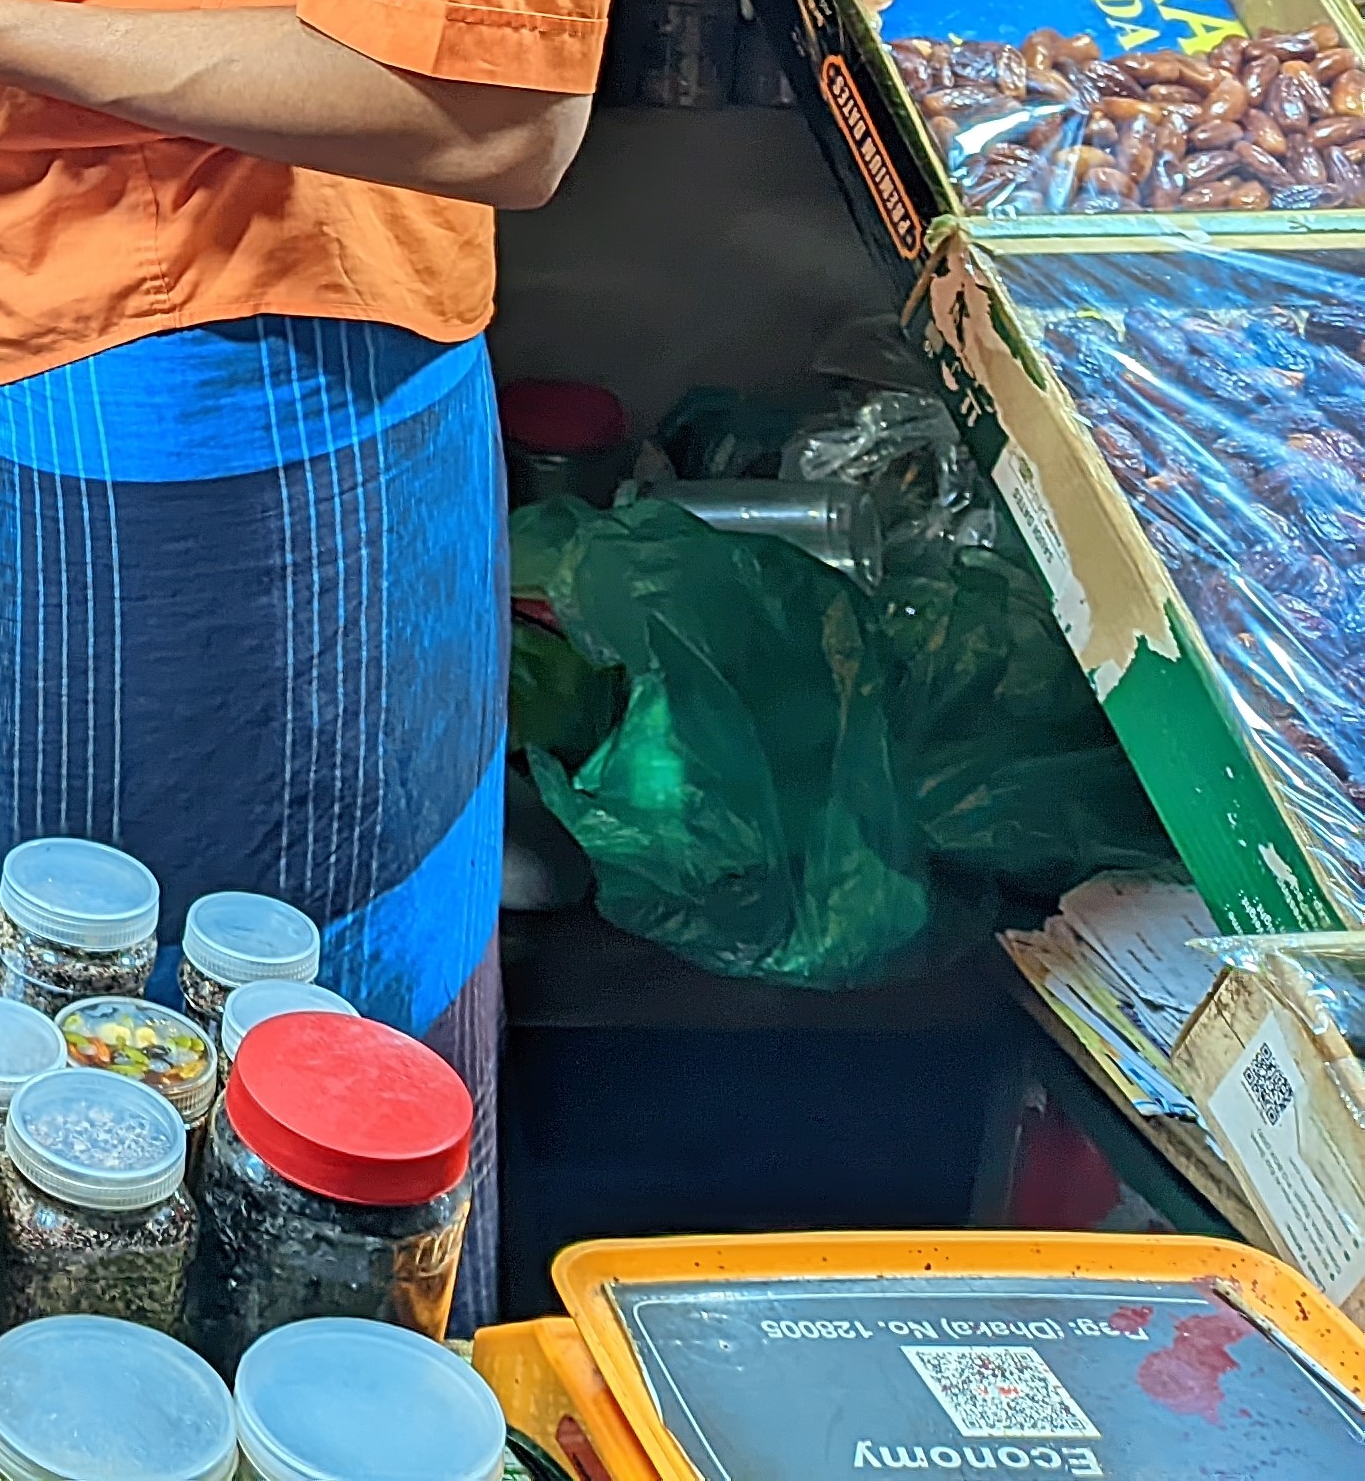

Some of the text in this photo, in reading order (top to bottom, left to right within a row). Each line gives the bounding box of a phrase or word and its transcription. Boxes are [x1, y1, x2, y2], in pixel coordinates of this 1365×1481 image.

[761, 1318, 872, 1341] 128005
[876, 1320, 939, 1342] No.
[850, 1439, 1104, 1476] Economy
